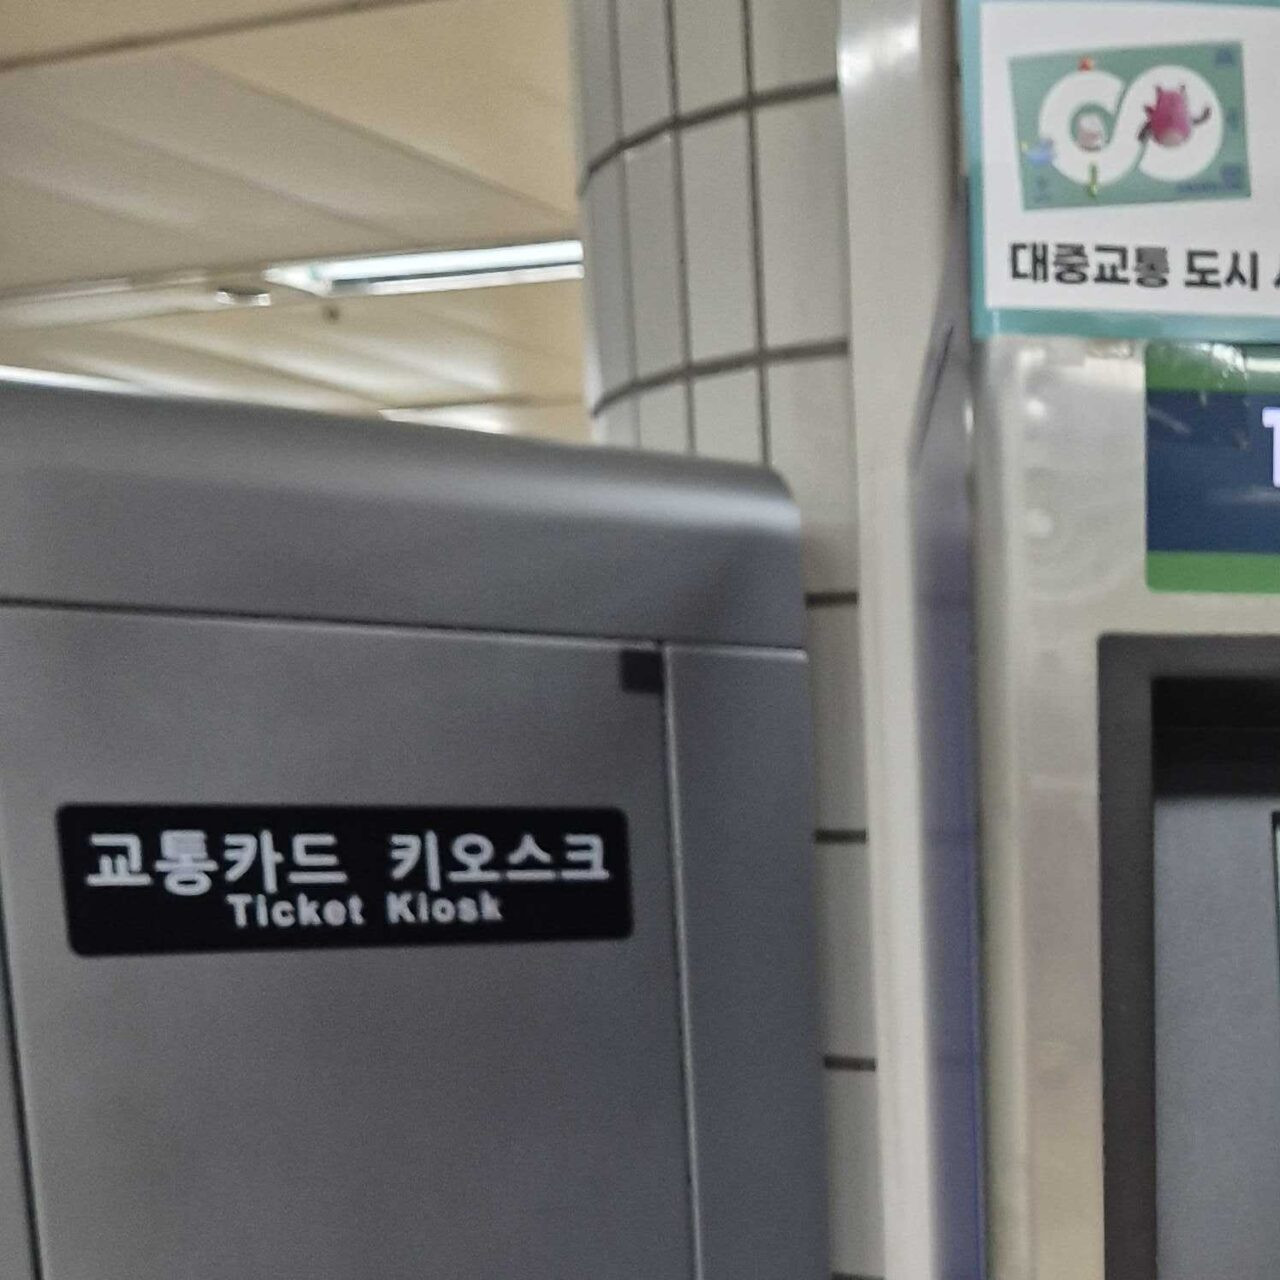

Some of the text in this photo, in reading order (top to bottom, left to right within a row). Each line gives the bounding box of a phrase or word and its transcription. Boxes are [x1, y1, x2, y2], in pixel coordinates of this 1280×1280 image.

[1009, 242, 1170, 288] 대중교통
[1185, 251, 1259, 291] 도시
[87, 829, 609, 894] 교통카드 키오스크
[226, 891, 502, 929] Ticket Kiosk
